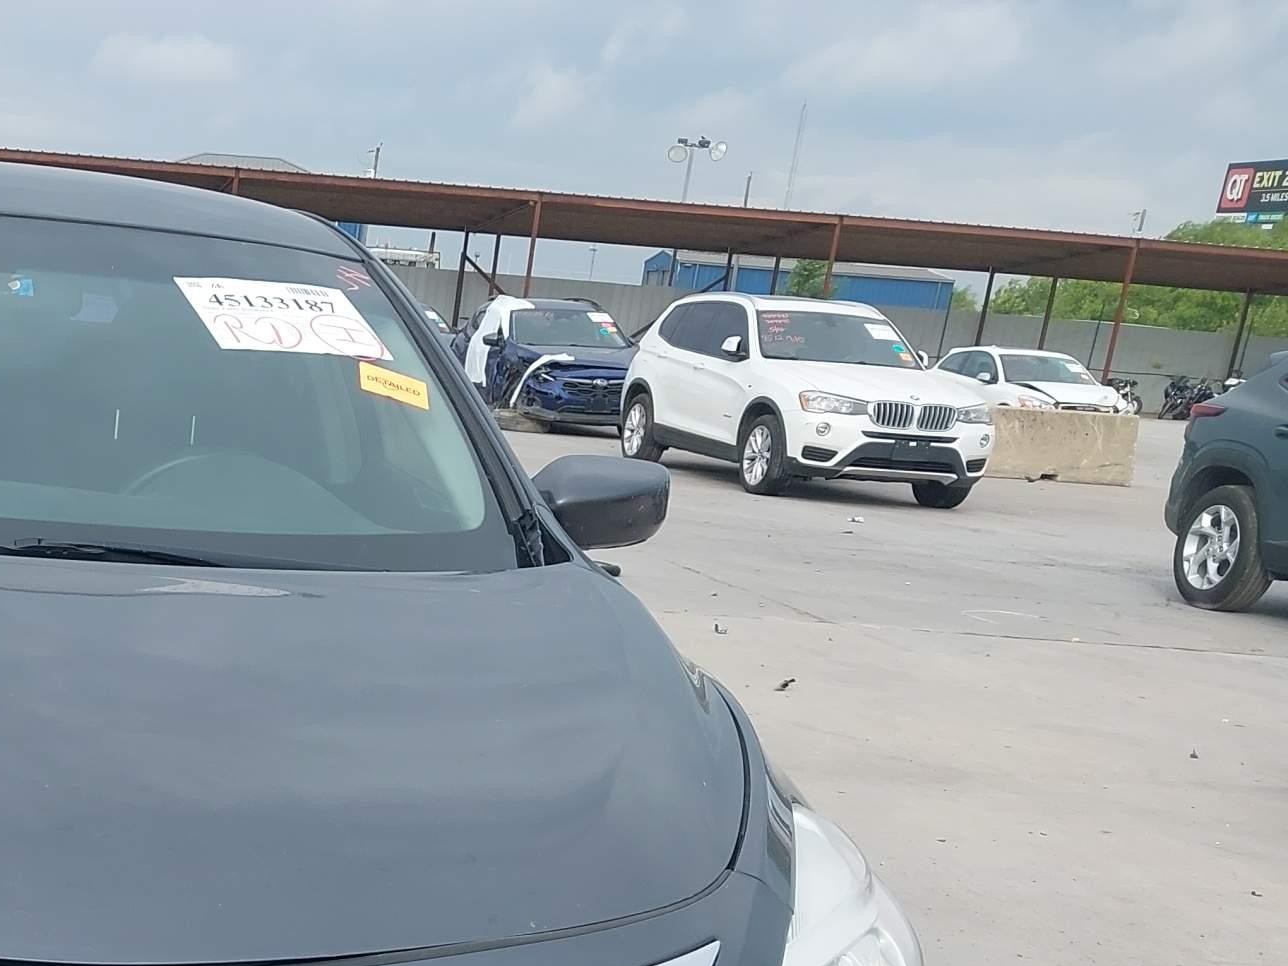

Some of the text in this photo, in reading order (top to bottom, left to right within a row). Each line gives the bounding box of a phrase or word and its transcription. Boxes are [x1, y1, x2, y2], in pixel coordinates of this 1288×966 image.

[1226, 174, 1249, 201] QT
[1253, 170, 1283, 188] EXIT
[208, 293, 336, 314] 45133187
[366, 374, 422, 397] DETAILED
